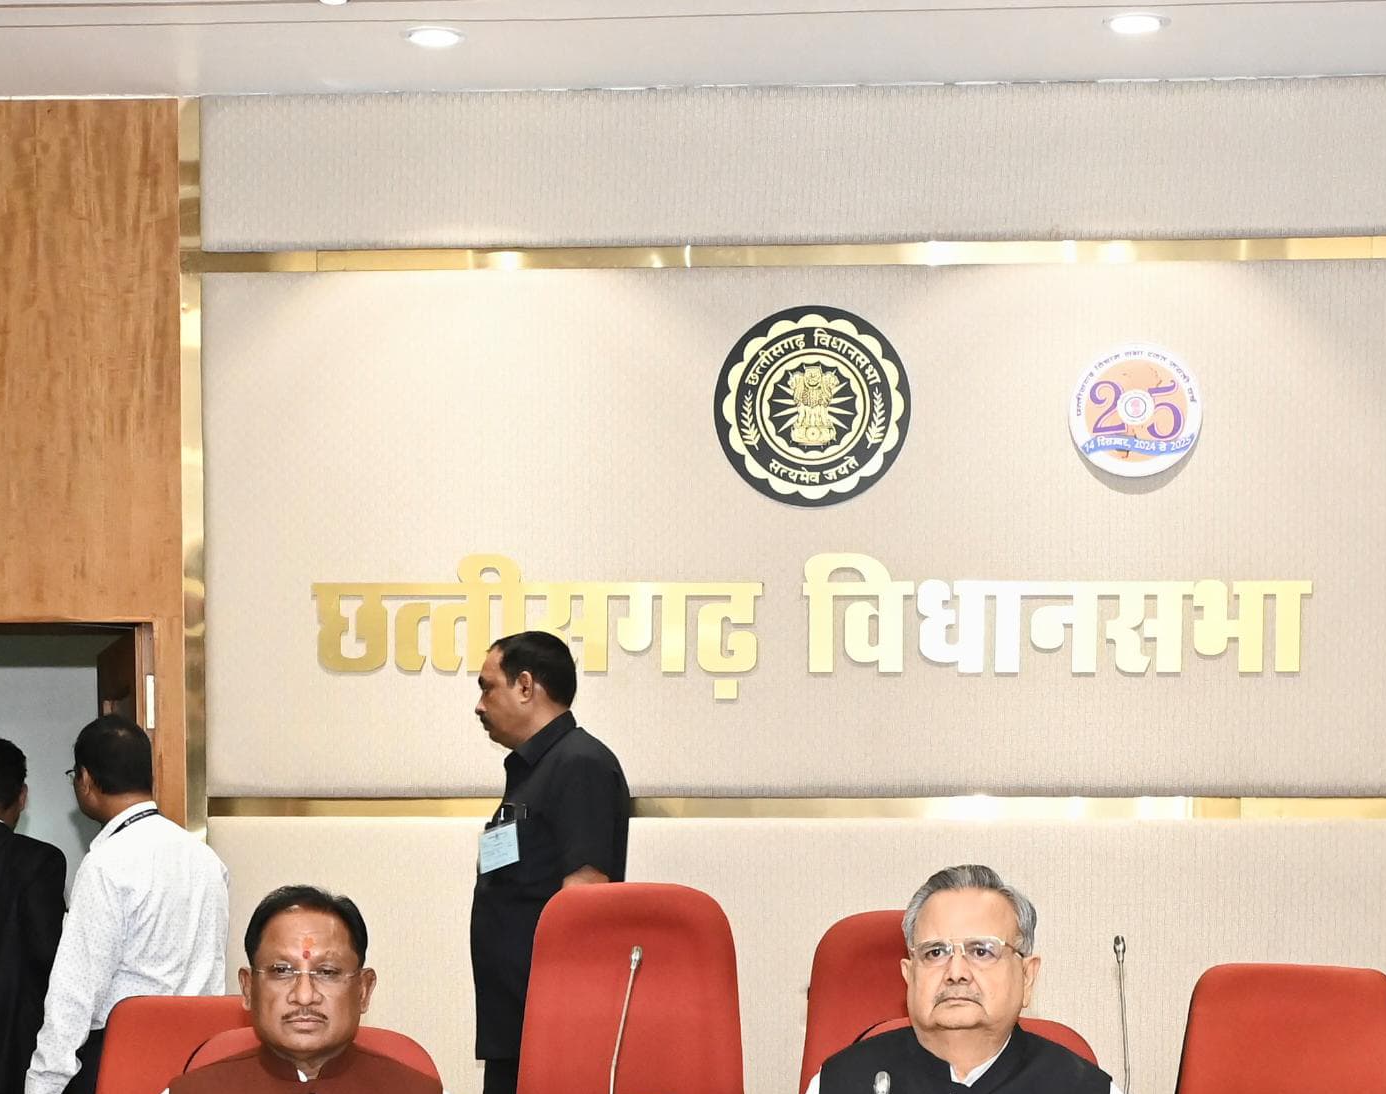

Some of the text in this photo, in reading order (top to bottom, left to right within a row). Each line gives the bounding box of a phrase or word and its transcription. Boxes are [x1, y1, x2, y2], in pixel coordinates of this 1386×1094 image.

[744, 327, 882, 386] छत्तीसगढ़ विधानसभा
[1089, 379, 1185, 441] 25
[769, 454, 861, 485] सत्यमेव जयते
[1133, 439, 1156, 451] 2024
[1169, 437, 1192, 451] 2025
[311, 551, 1314, 701] छत्तीसगढ़ विधानसभा
